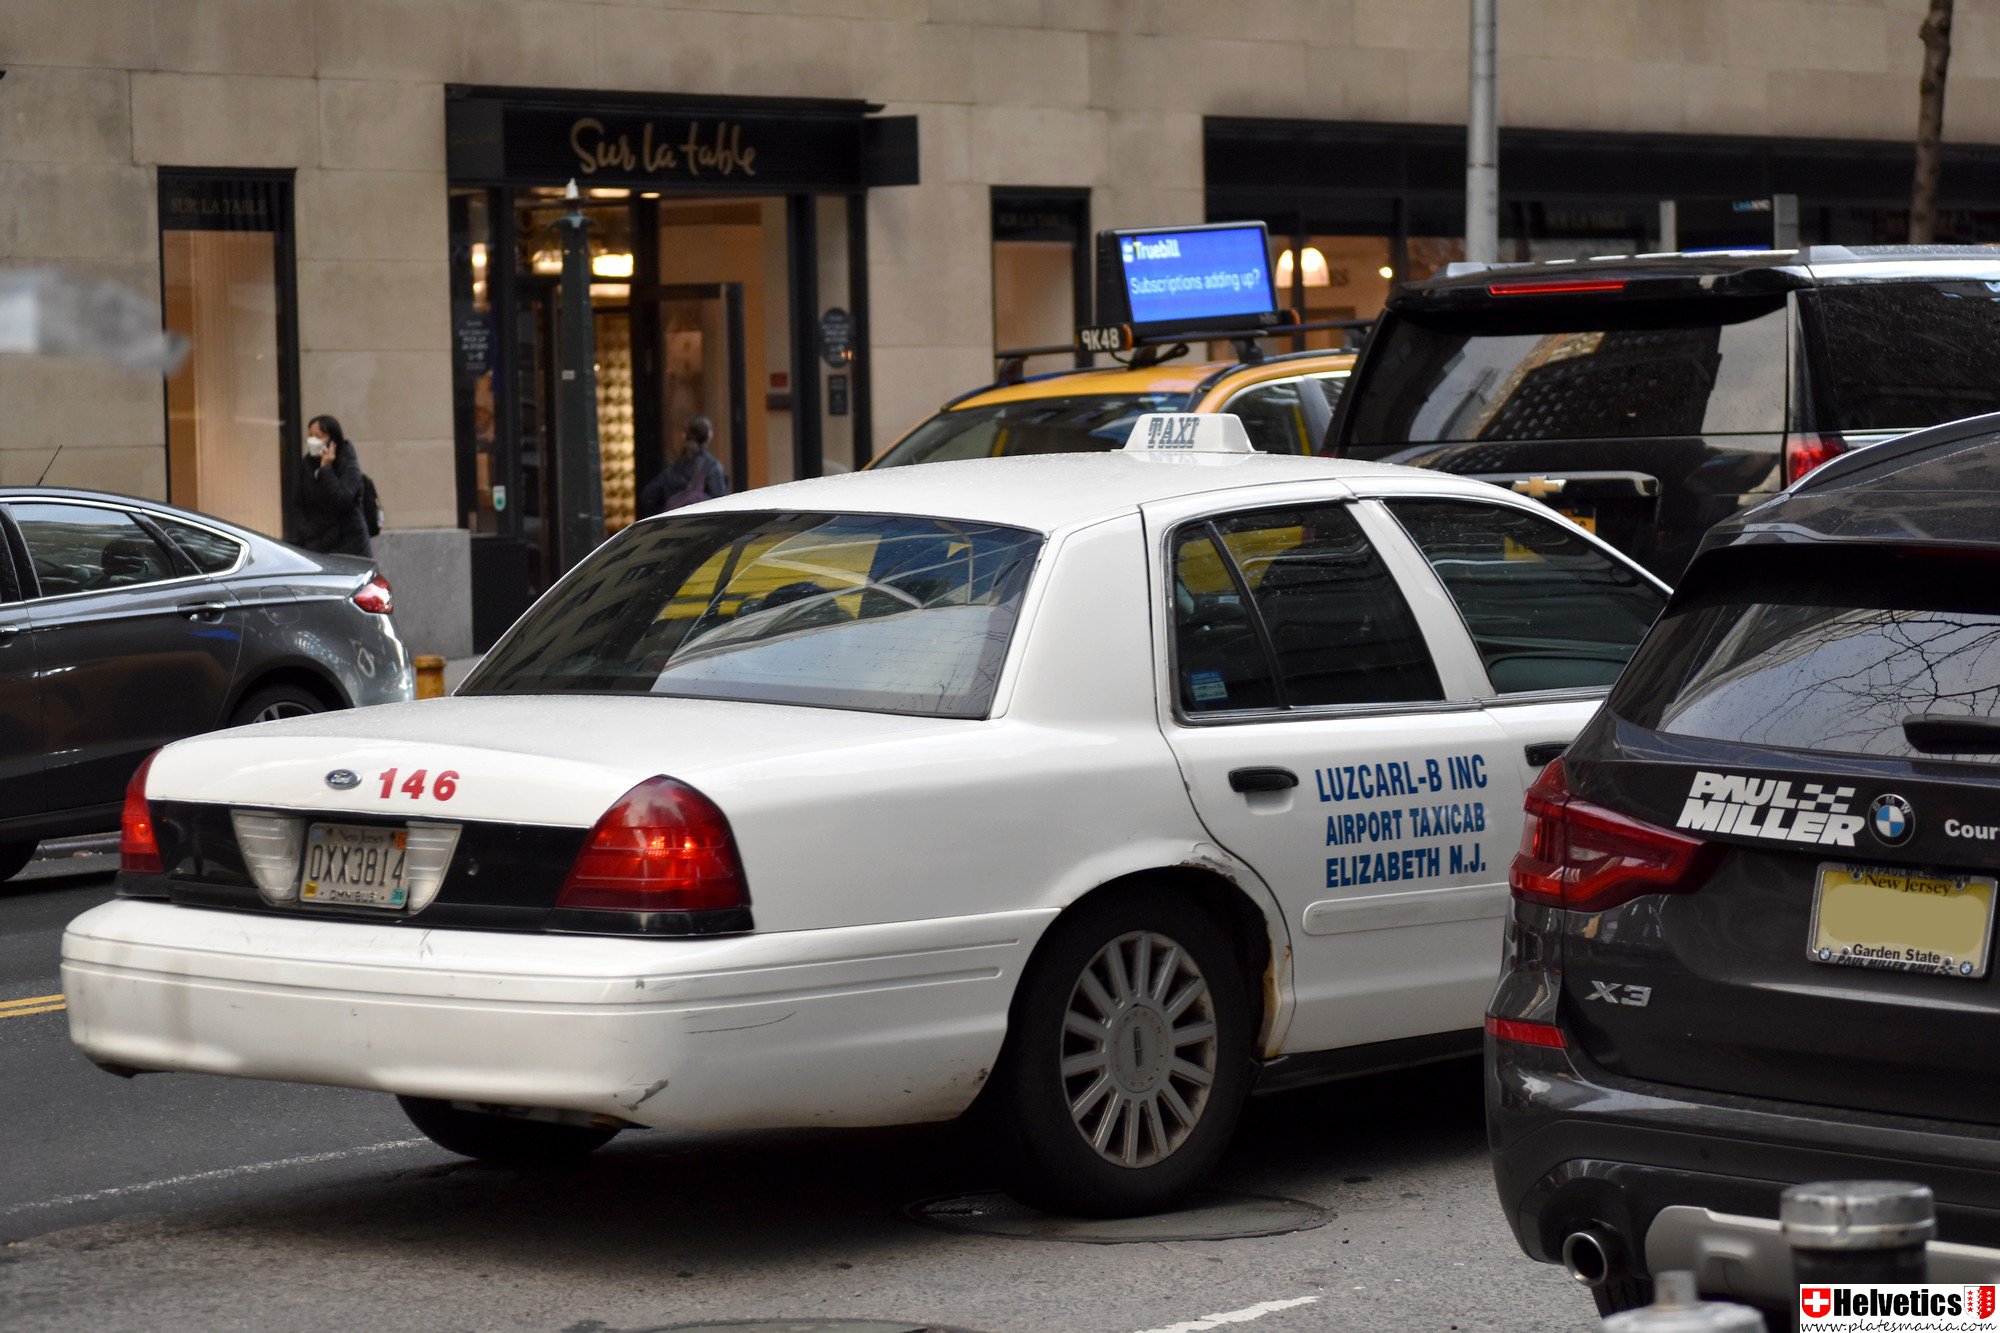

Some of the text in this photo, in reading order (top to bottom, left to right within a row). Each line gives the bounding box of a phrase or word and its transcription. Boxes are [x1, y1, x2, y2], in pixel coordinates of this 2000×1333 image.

[570, 117, 756, 176] Sur la table
[1133, 239, 1181, 260] Truebill
[1130, 268, 1261, 295] Subscriptions adding up?
[1081, 327, 1120, 350] 9K48
[1147, 417, 1200, 449] TAXI
[379, 768, 460, 801] 146
[1315, 754, 1487, 802] LUZCARL-B INC
[1688, 771, 1798, 809] PAUL
[1326, 802, 1486, 846] AIRPORT TAXICAB
[1676, 798, 1865, 847] MILLER
[1326, 843, 1486, 888] ELIZABETH N.J.
[1864, 874, 1952, 896] New Jersey
[1836, 955, 1938, 975] PAUL MILLER BMW
[1852, 944, 1941, 963] Garden State
[1584, 980, 1652, 1007] X3
